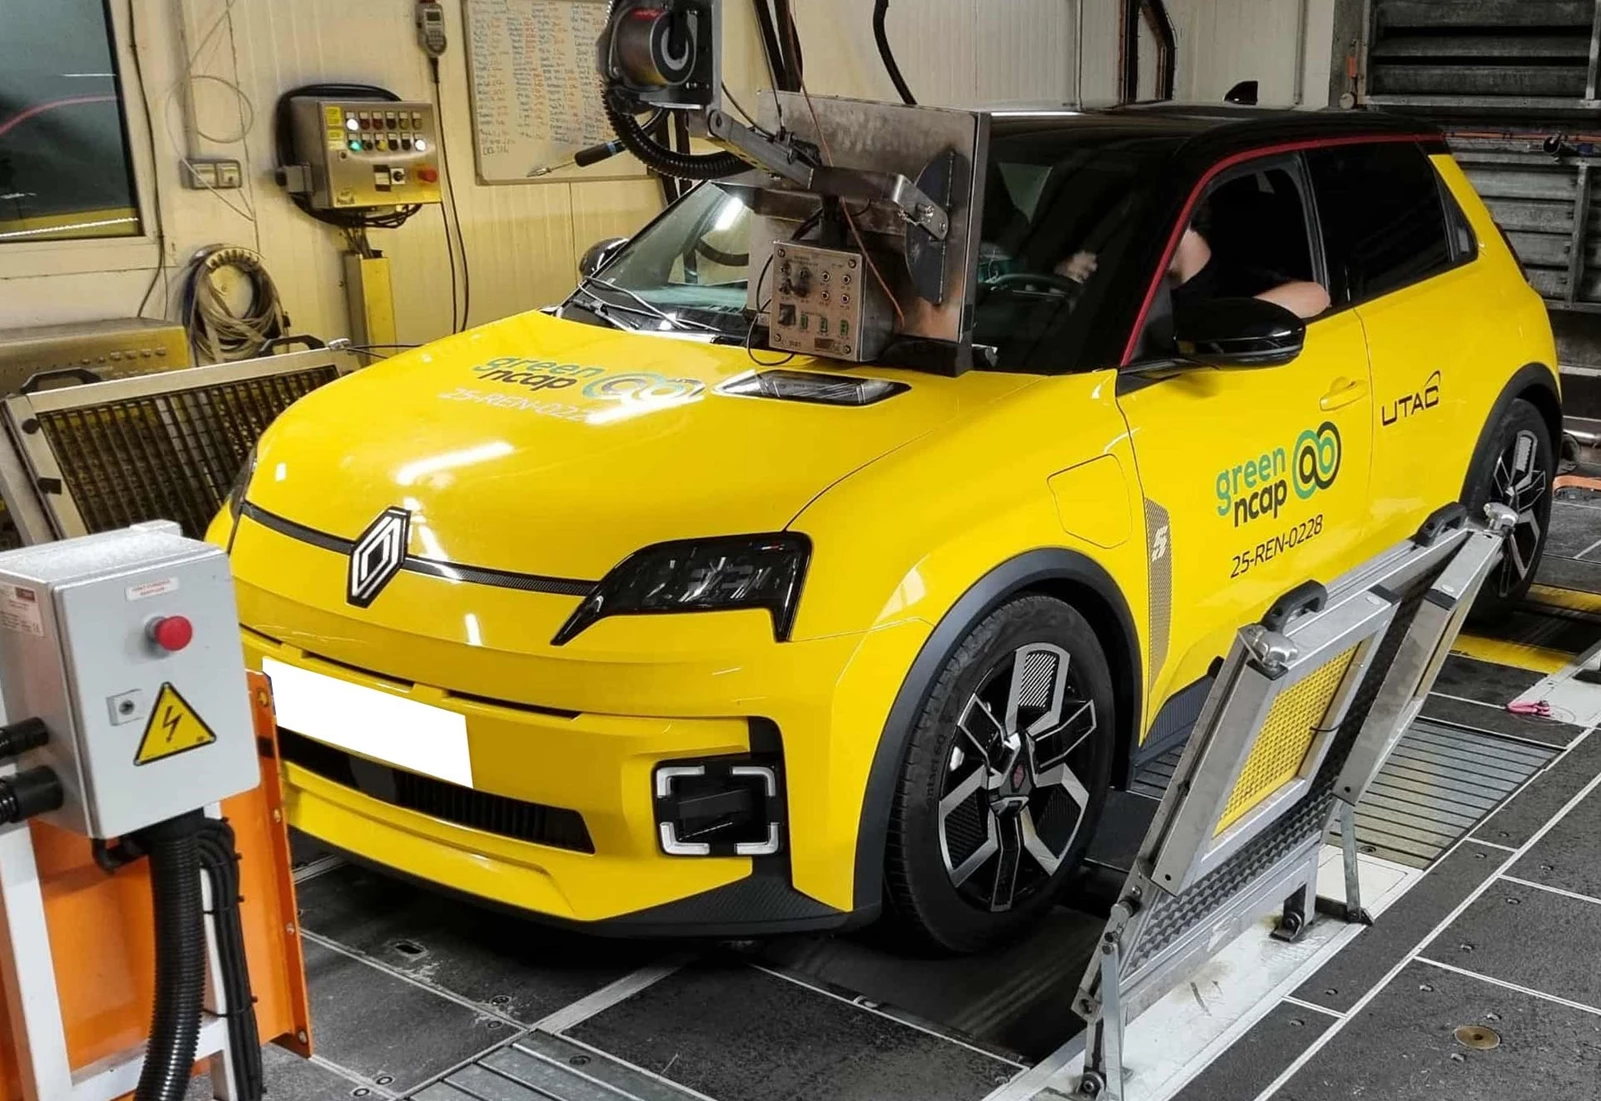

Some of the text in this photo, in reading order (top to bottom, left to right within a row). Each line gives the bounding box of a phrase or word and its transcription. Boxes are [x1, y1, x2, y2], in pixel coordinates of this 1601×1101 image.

[473, 356, 604, 378] green
[478, 369, 578, 391] ncap
[438, 387, 592, 421] 25-REN-022
[1382, 384, 1439, 426] UTAC
[1216, 447, 1286, 516] green
[1234, 479, 1287, 527] ncap
[1230, 514, 1323, 578] 25-REN-0228
